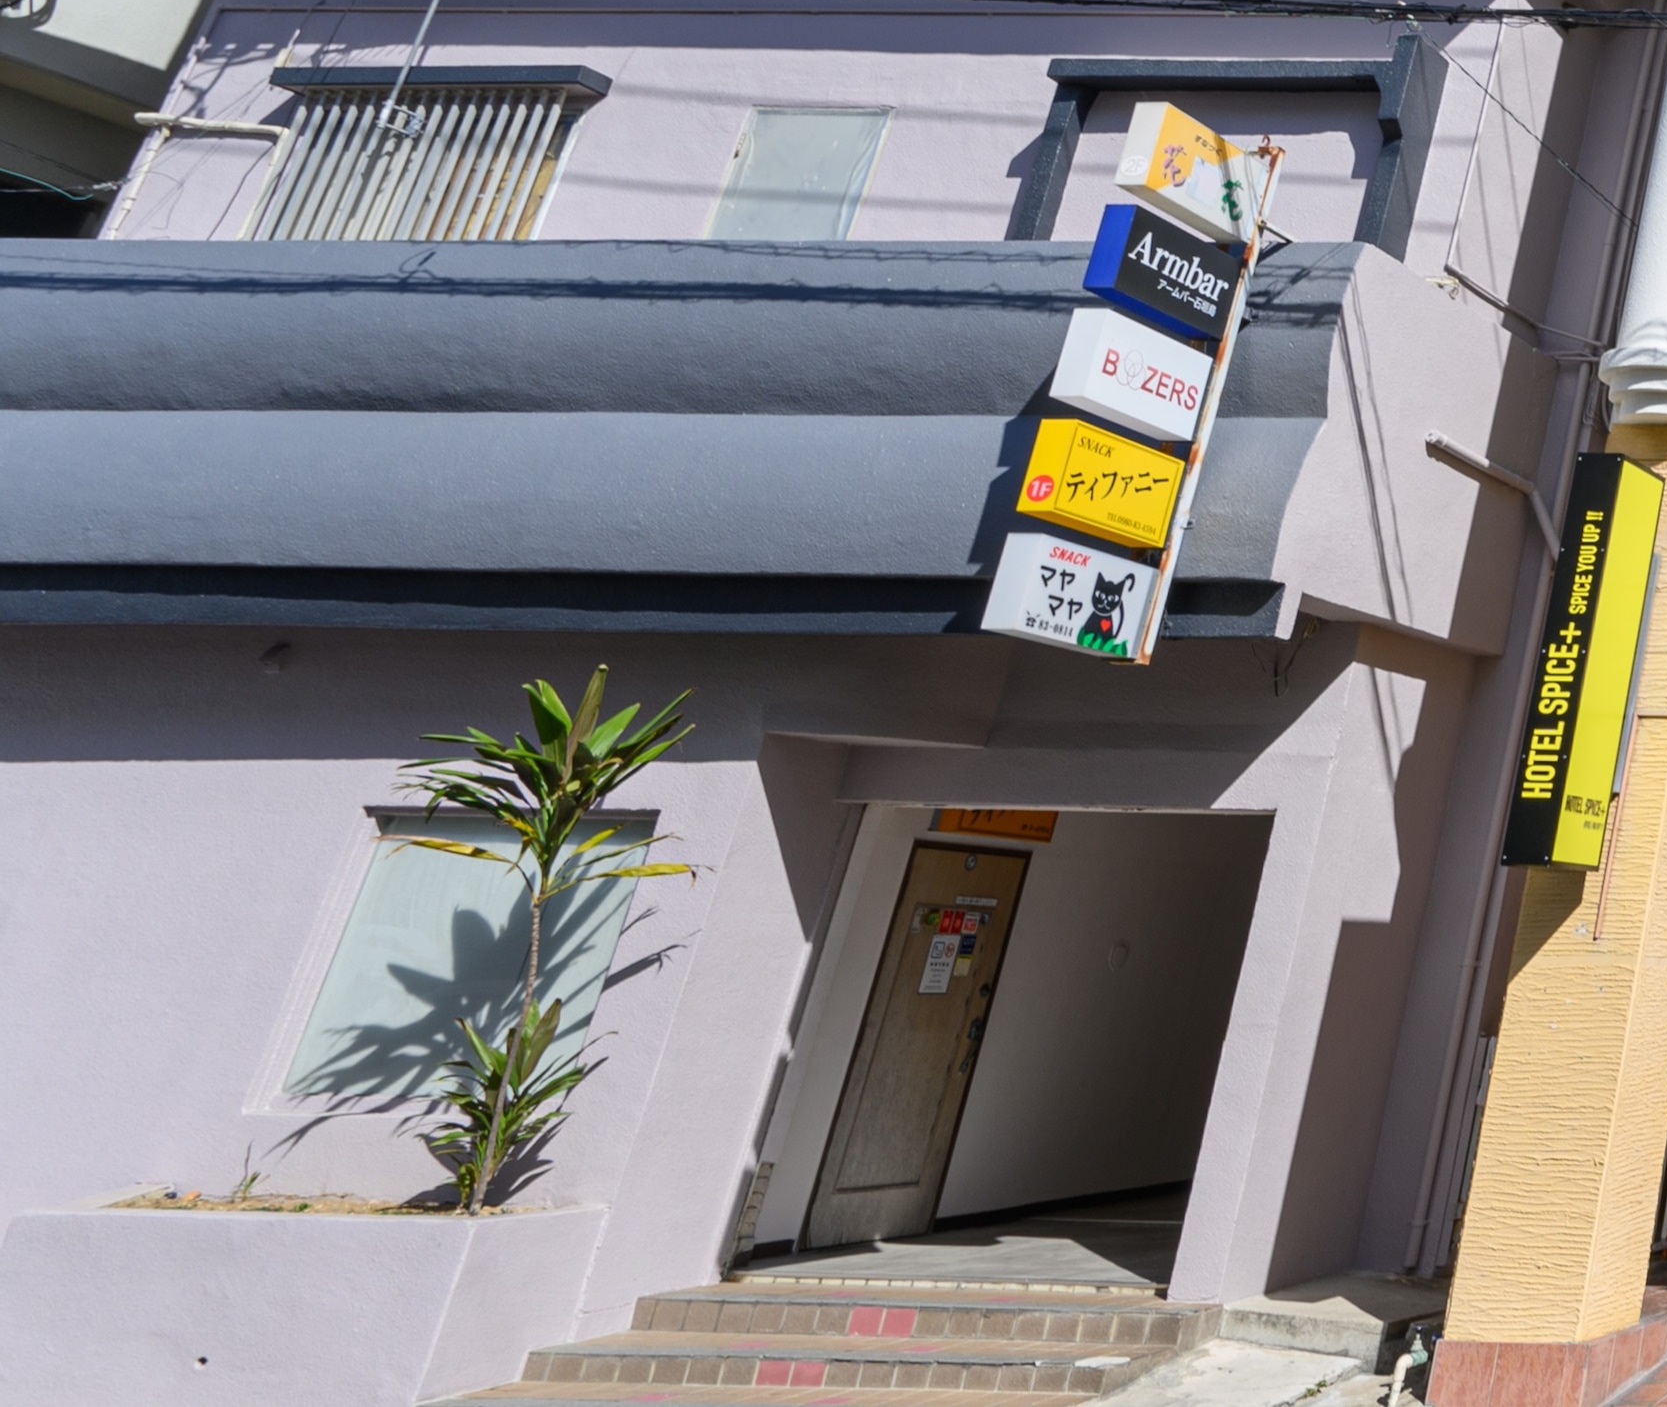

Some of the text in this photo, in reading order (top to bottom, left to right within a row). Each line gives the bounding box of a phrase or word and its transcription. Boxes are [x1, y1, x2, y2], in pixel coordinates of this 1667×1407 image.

[1128, 231, 1229, 302] Armbar
[1077, 436, 1115, 459] SNACK
[1031, 480, 1053, 498] 1F
[1066, 471, 1170, 503] ティファニー
[1582, 523, 1601, 543] UP
[1049, 546, 1091, 567] SNACK
[1576, 545, 1598, 572] YOU
[1040, 565, 1076, 591] マヤ
[1048, 594, 1083, 620] マヤ
[1568, 574, 1593, 614] SPICE
[1538, 621, 1582, 716] SPICE+
[1521, 720, 1565, 800] HOTEL
